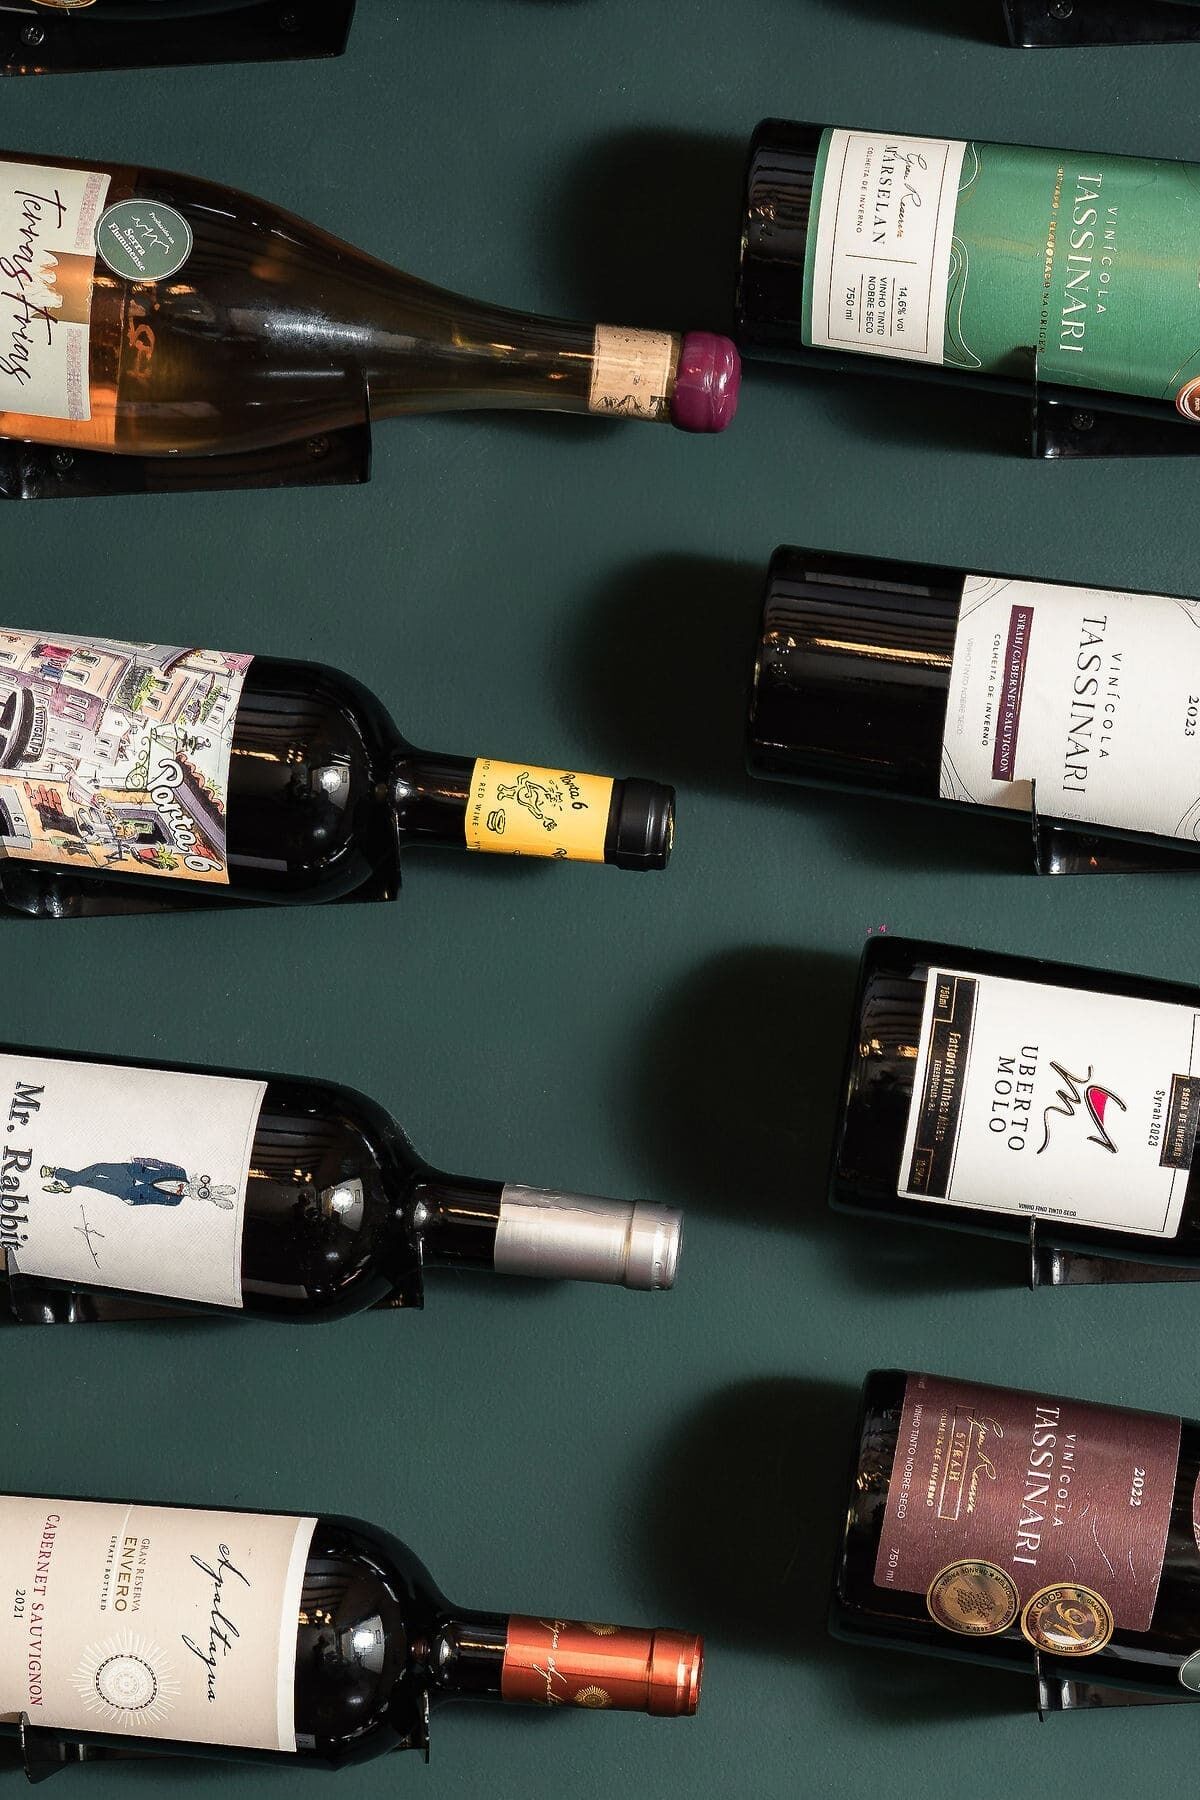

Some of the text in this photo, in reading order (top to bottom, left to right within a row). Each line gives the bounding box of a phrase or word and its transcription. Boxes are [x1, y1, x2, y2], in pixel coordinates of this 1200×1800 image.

[856, 147, 874, 233] COLHEITA DE INVERNO
[871, 145, 898, 246] MARSELAN
[107, 222, 147, 272] Fluminense
[124, 228, 147, 256] Serra
[1059, 173, 1102, 353] TASSINARI
[1097, 207, 1118, 314] VINÍCOLA
[845, 287, 855, 321] 750 ml
[865, 276, 876, 334] NOBRE SECO
[877, 277, 887, 335] VINHO TINTO
[896, 287, 907, 332] 14,6% vol
[982, 634, 1001, 746] COLHEITA DE INVERNO
[1000, 613, 1027, 772] SYRAH/CABERNET SAUVIGNON
[1062, 615, 1107, 793] TASSINARI
[1099, 653, 1122, 758] VINÍCOLA
[1185, 695, 1199, 736] 2023
[146, 759, 223, 872] Porta 6
[472, 782, 486, 826] RED WINE
[560, 773, 588, 810] Porta 6
[937, 985, 951, 1008] 750ml
[942, 1031, 961, 1075] Fattoria
[938, 1078, 956, 1112] Vinhas
[988, 1056, 1015, 1133] MOLO
[1007, 1046, 1039, 1151] UBERTO
[1147, 1090, 1166, 1147] Syrah 2023
[1176, 1112, 1188, 1123] DE
[1178, 1087, 1192, 1110] SAFRA
[0, 1081, 46, 1251] Mr. Rabbit
[897, 1404, 924, 1519] VINHO TINTO NOBRE SECO
[1013, 1406, 1060, 1566] TASSINARI
[1052, 1434, 1076, 1527] VINÍCOLA
[1130, 1468, 1145, 1507] 2022
[100, 1535, 117, 1610] ESTATE BOTTLED
[115, 1536, 138, 1612] ENVERO
[131, 1538, 150, 1612] GRAN RESERVA
[885, 1548, 900, 1582] 750 ml
[13, 1589, 26, 1620] 2021
[29, 1514, 60, 1706] CABERNET SAUVIGNON
[181, 1544, 250, 1703] Apaltagua
